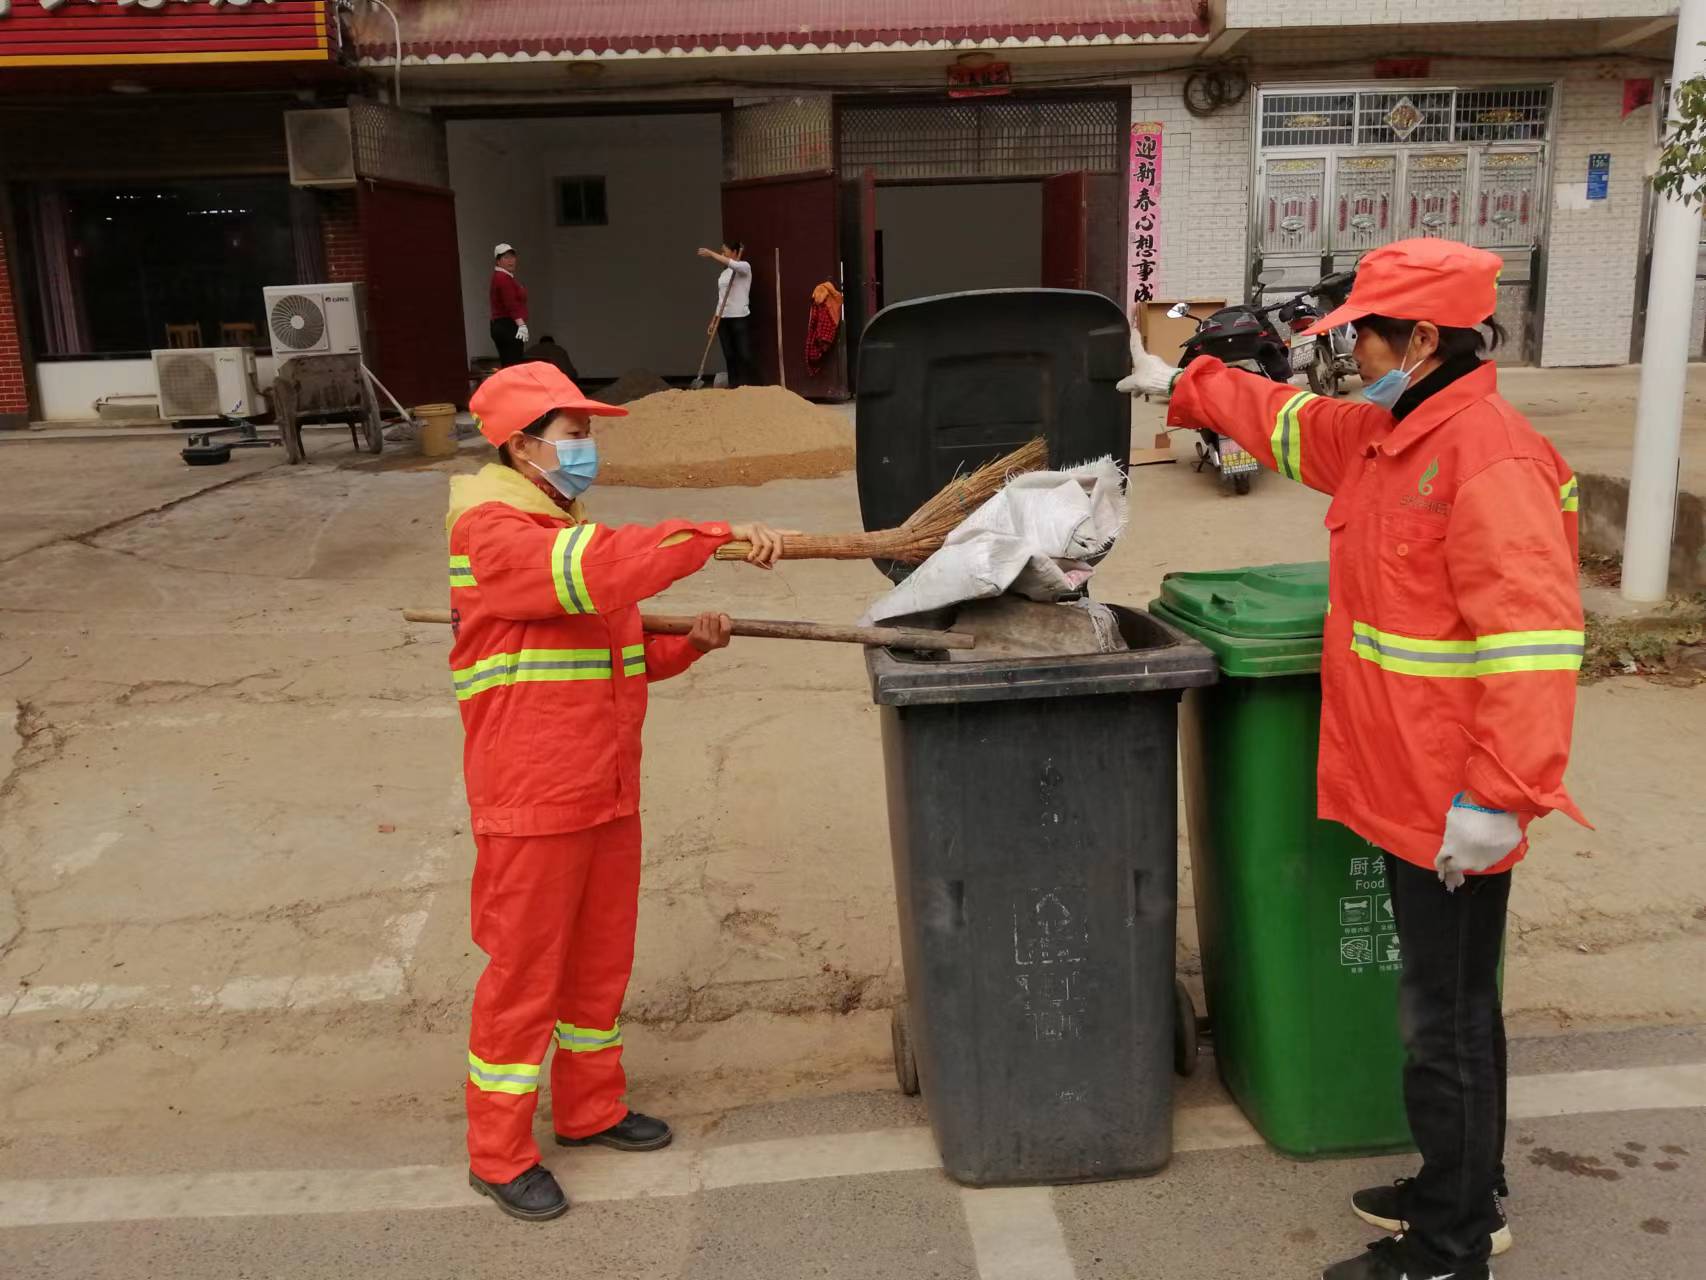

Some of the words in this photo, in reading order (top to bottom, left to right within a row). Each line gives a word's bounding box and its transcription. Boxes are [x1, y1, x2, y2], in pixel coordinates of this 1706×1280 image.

[1132, 135, 1157, 303] 迎新春心想事成
[1349, 855, 1387, 876] 厨余
[1355, 878, 1385, 891] Food
